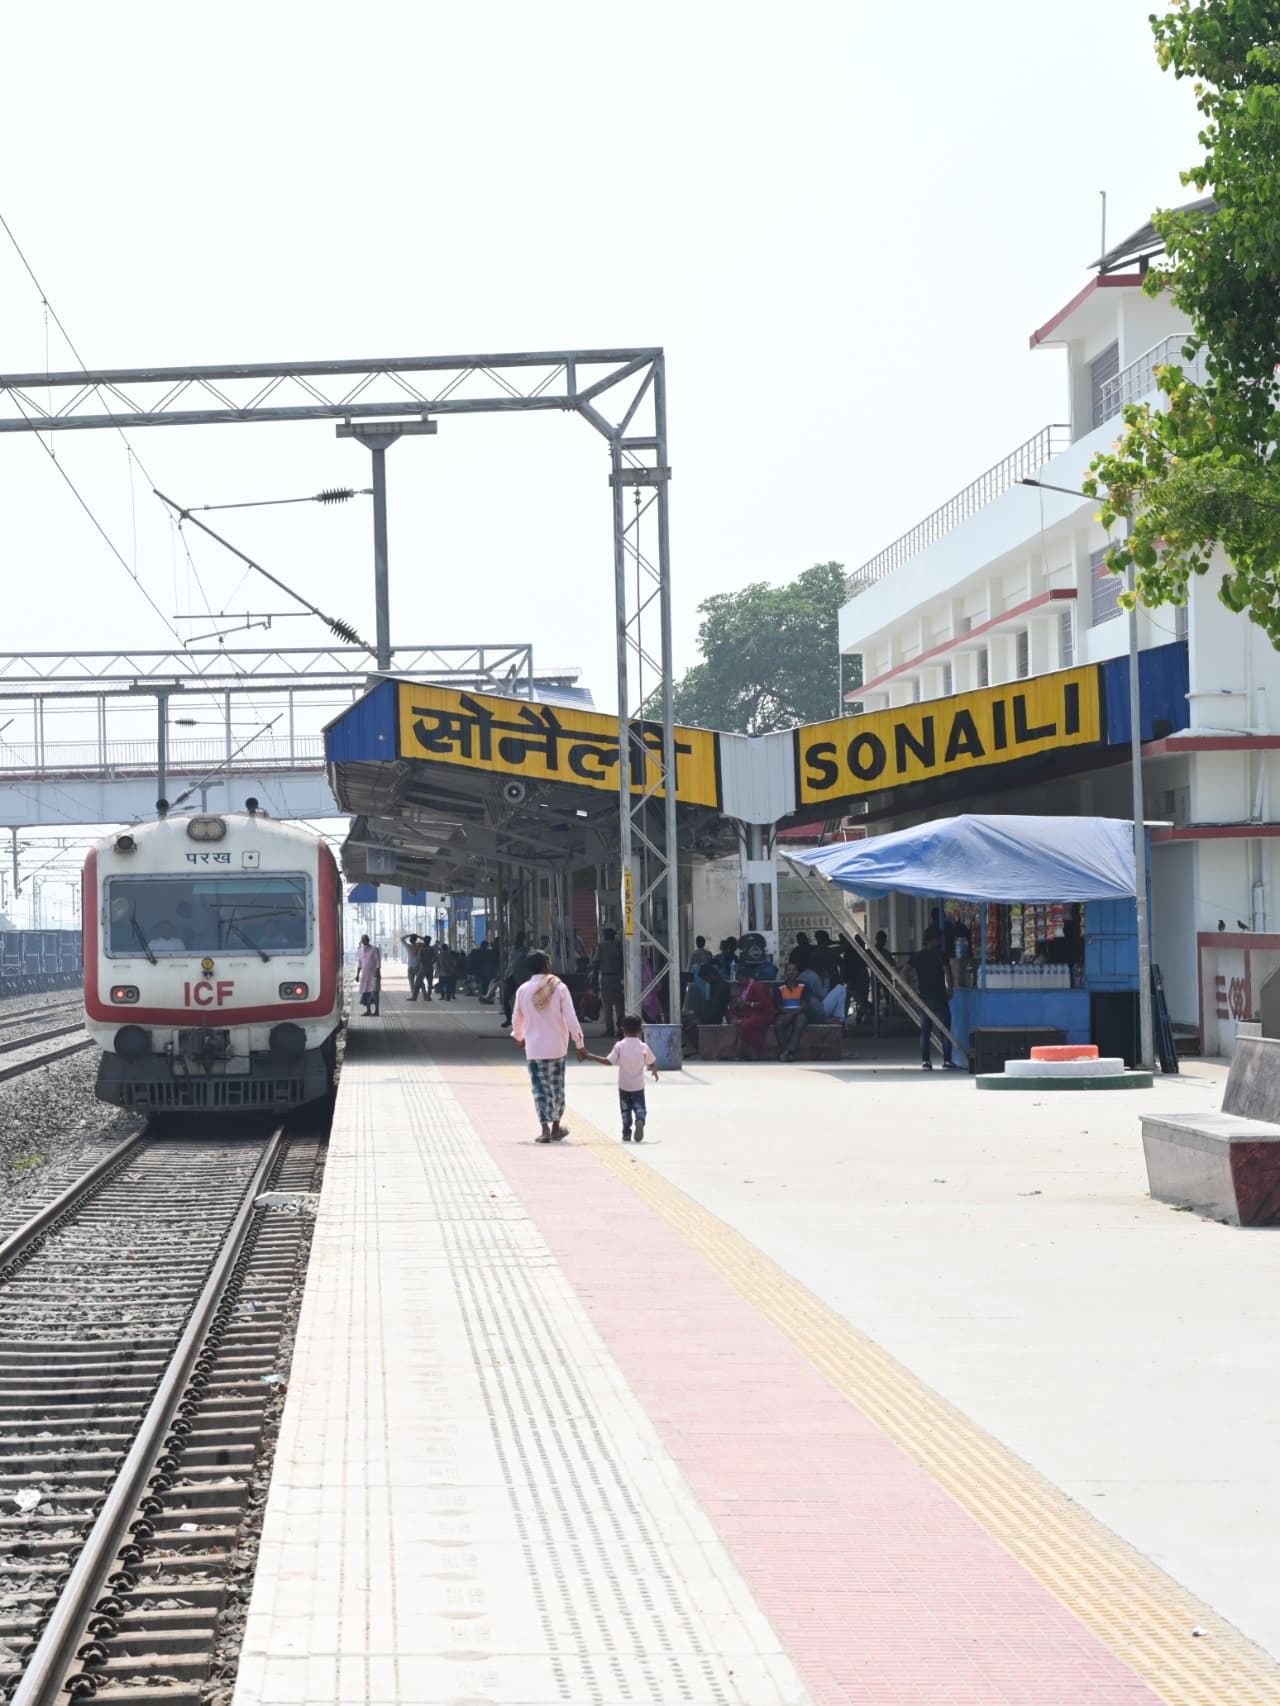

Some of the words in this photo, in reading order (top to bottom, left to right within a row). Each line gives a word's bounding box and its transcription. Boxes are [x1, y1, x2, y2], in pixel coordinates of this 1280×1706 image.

[411, 693, 692, 791] सोनैली
[805, 682, 1081, 790] SONAILI
[184, 852, 232, 864] परख
[184, 981, 234, 1007] ICF
